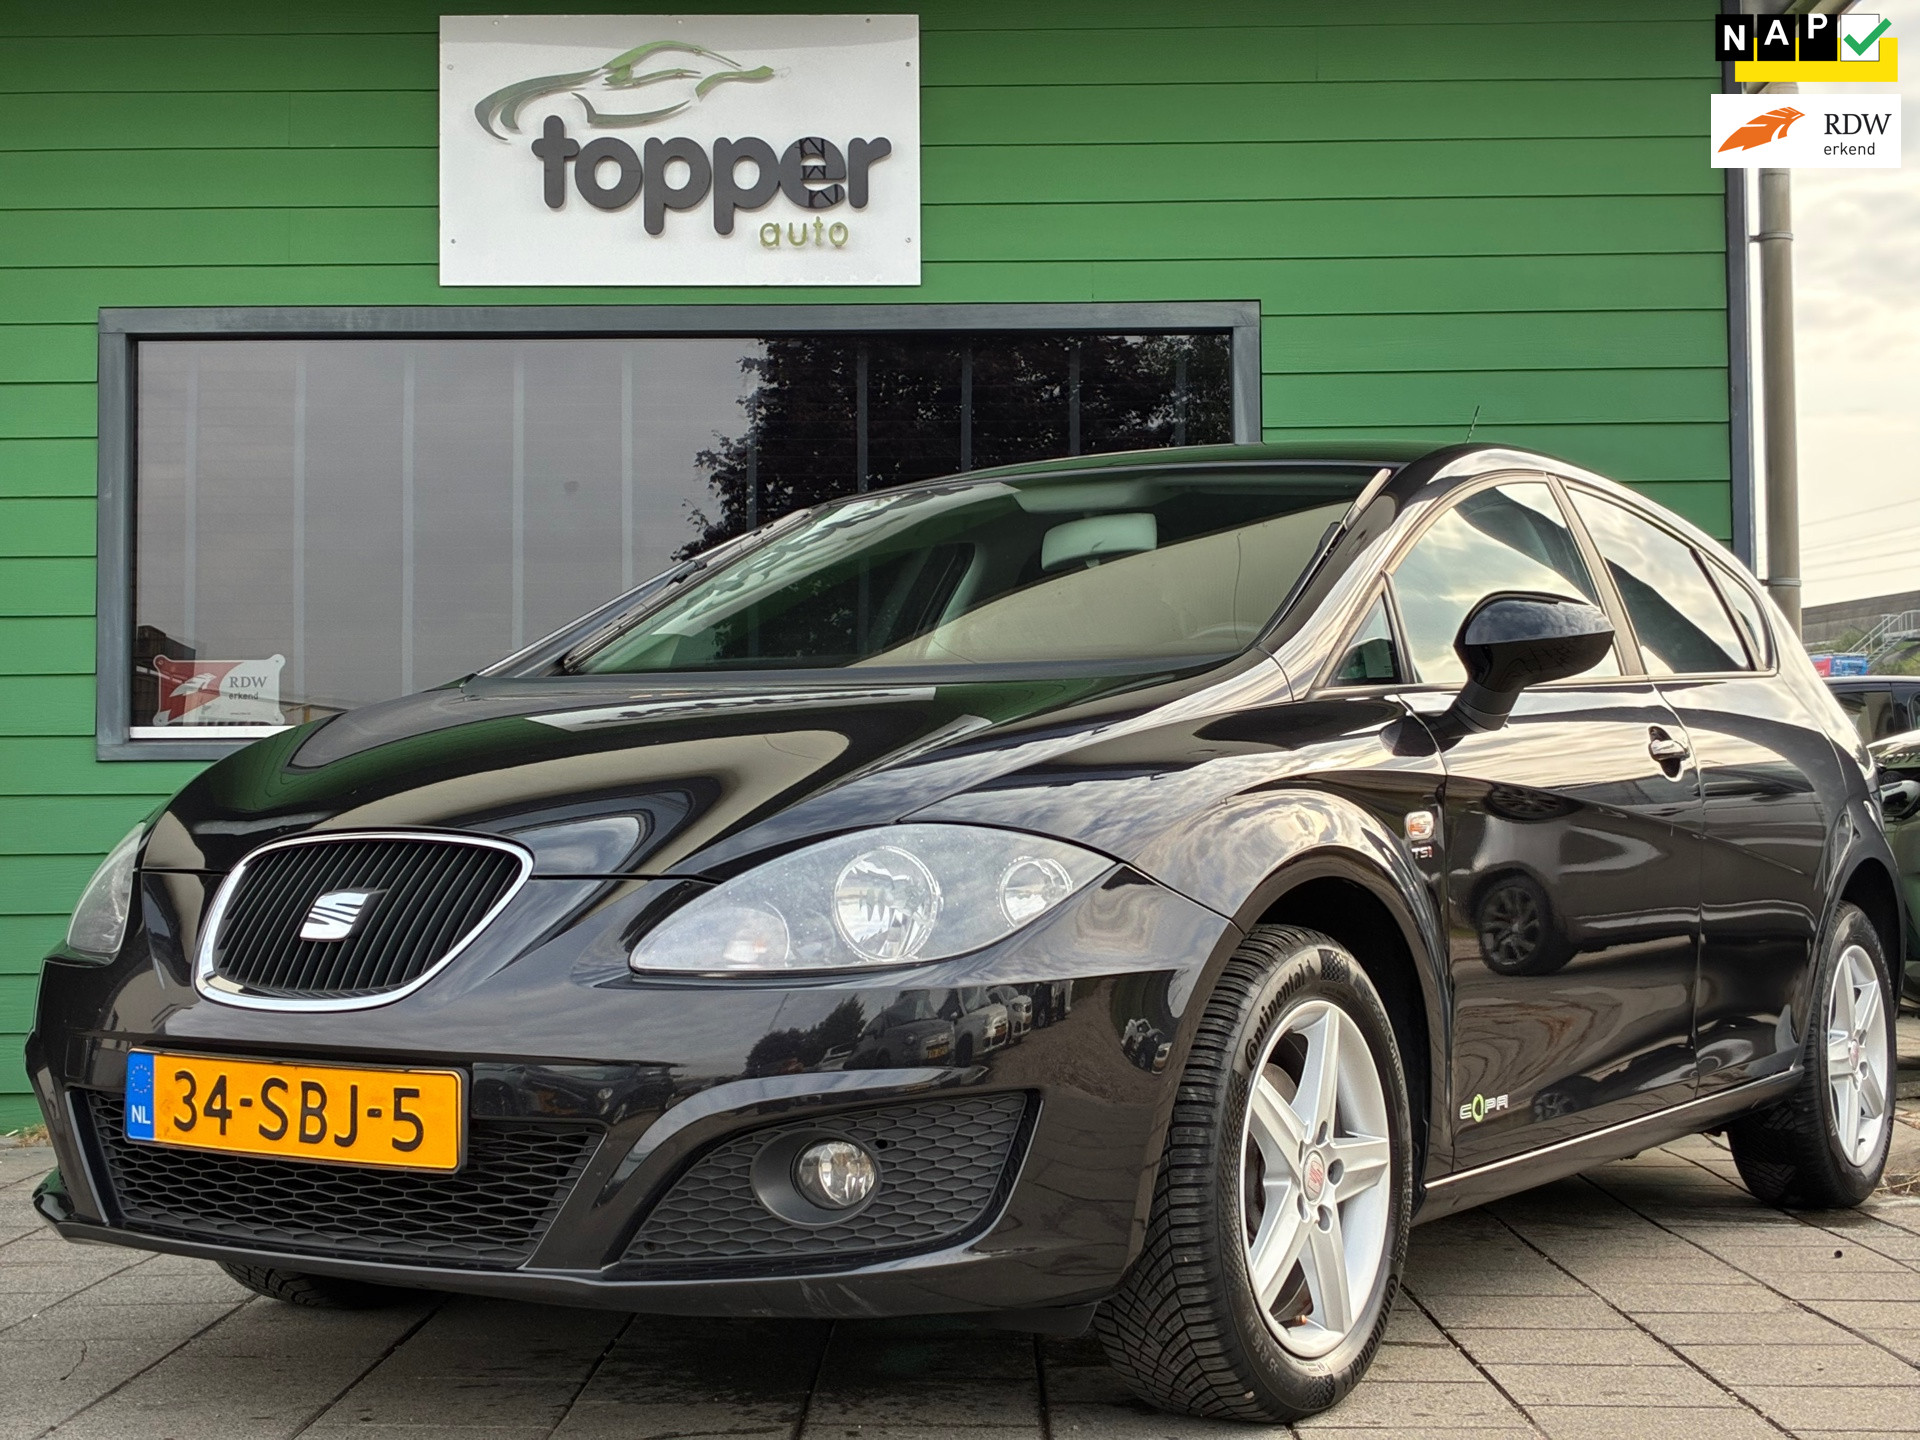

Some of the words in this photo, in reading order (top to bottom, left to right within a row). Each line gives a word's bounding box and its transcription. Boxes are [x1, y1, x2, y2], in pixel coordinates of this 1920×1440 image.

[531, 115, 892, 236] topper
[760, 217, 849, 247] auto
[228, 692, 259, 700] erkend
[229, 676, 267, 688] RDW
[1244, 963, 1306, 1072] Continental
[131, 1104, 151, 1125] NL
[173, 1070, 424, 1152] 34-SBJ-5
